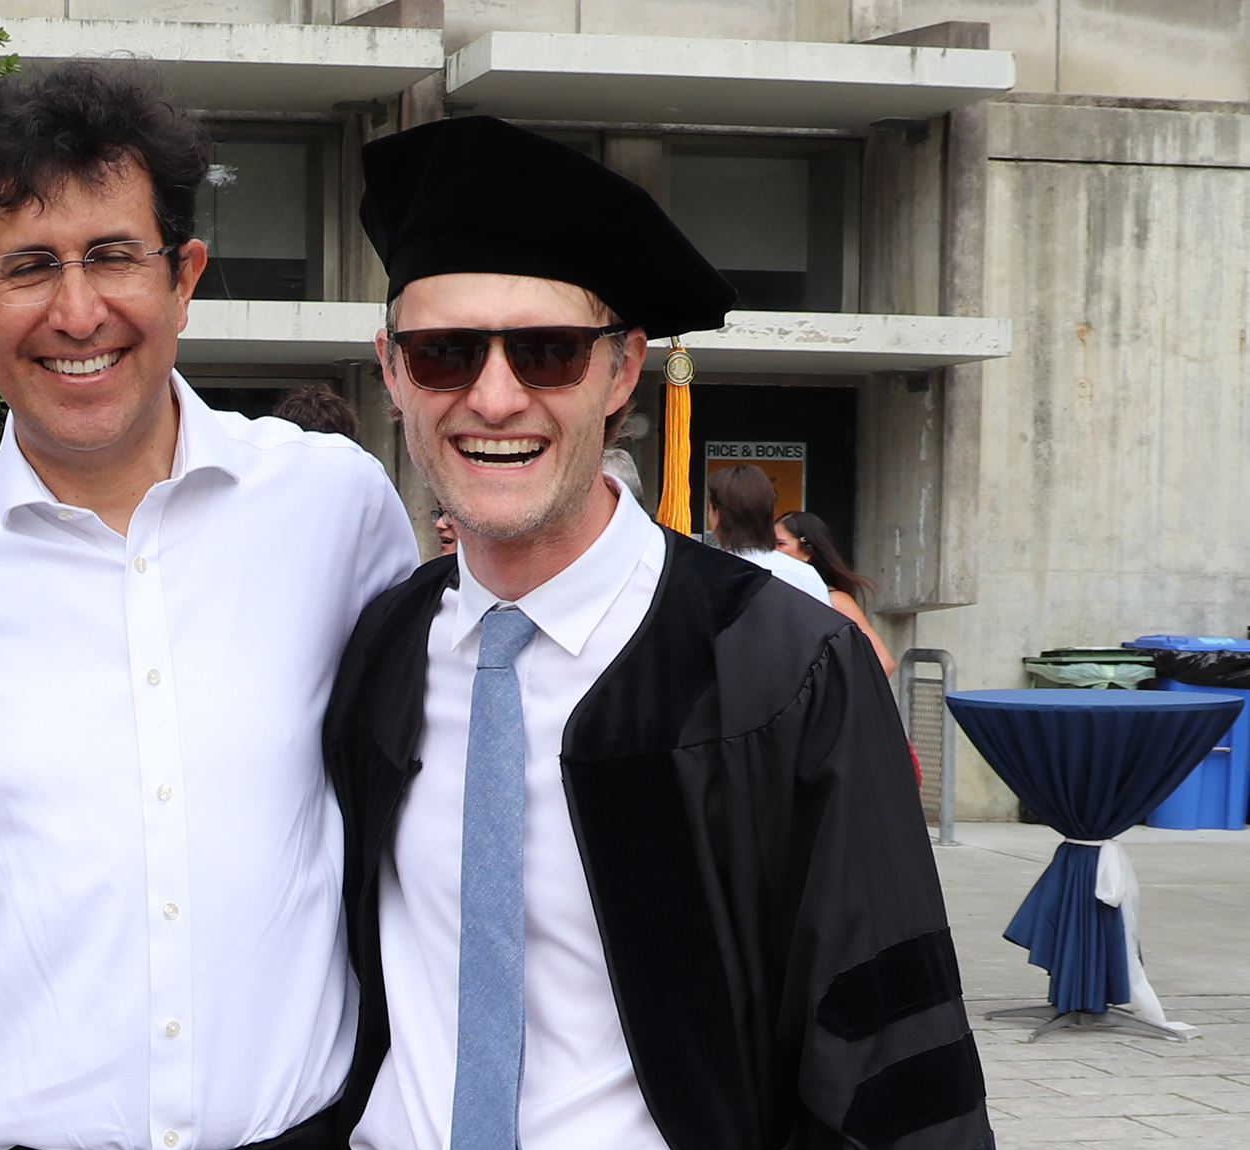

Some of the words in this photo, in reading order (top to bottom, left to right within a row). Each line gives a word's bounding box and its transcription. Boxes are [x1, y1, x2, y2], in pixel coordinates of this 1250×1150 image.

[707, 444, 738, 457] RICE
[741, 445, 752, 457] &
[756, 445, 803, 458] BONES
